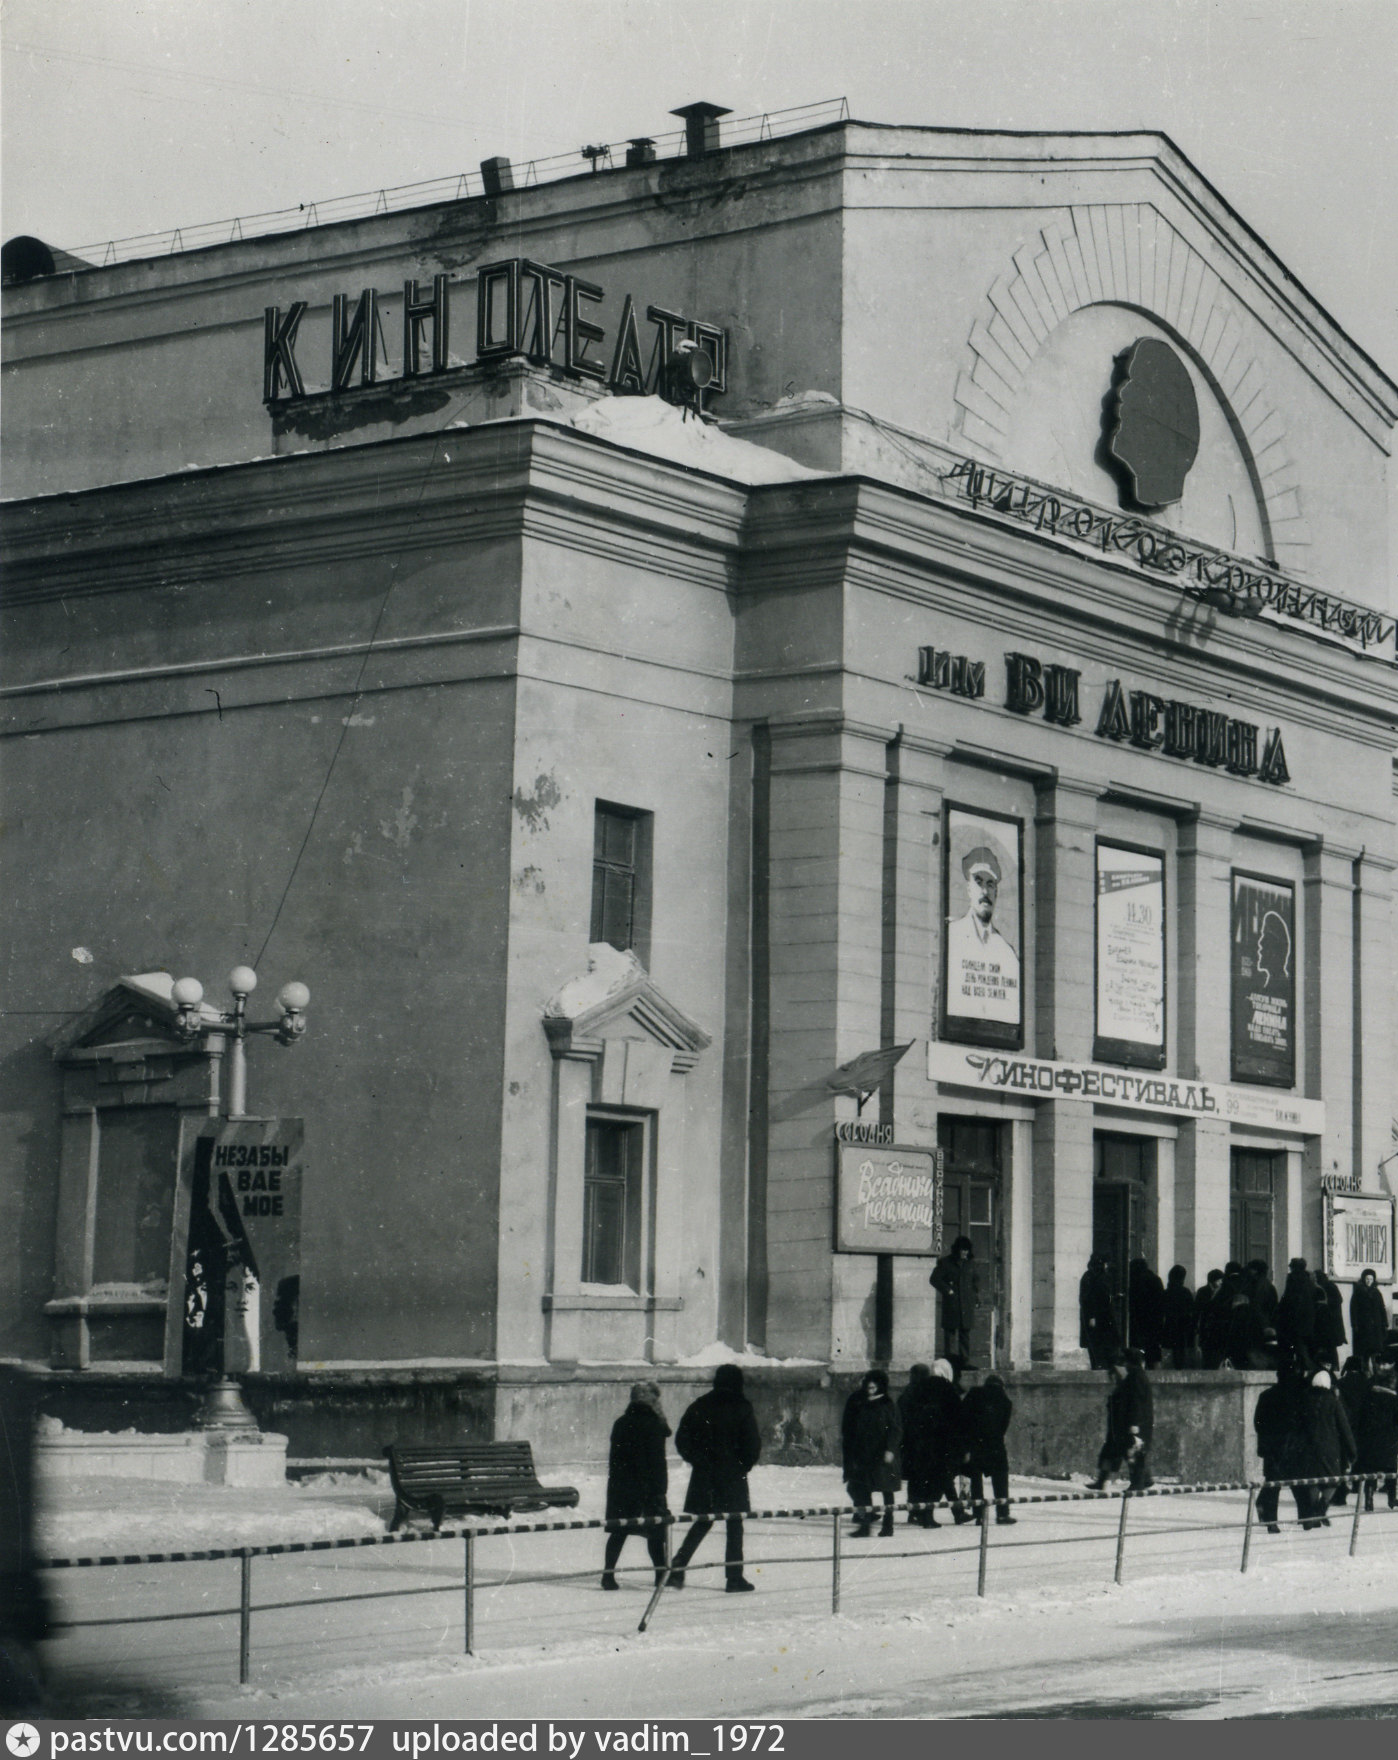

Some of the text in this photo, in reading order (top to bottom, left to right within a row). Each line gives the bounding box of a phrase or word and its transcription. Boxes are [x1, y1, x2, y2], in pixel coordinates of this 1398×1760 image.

[1094, 679, 1291, 786] ЛЕНИНА
[1252, 1010, 1287, 1031] ЛЕНИНА
[834, 1120, 894, 1145] СЕГОДНЯ
[215, 1145, 289, 1167] НЕЗАБЫ
[237, 1169, 281, 1192] ВАЕ
[243, 1195, 284, 1217] МОЕ
